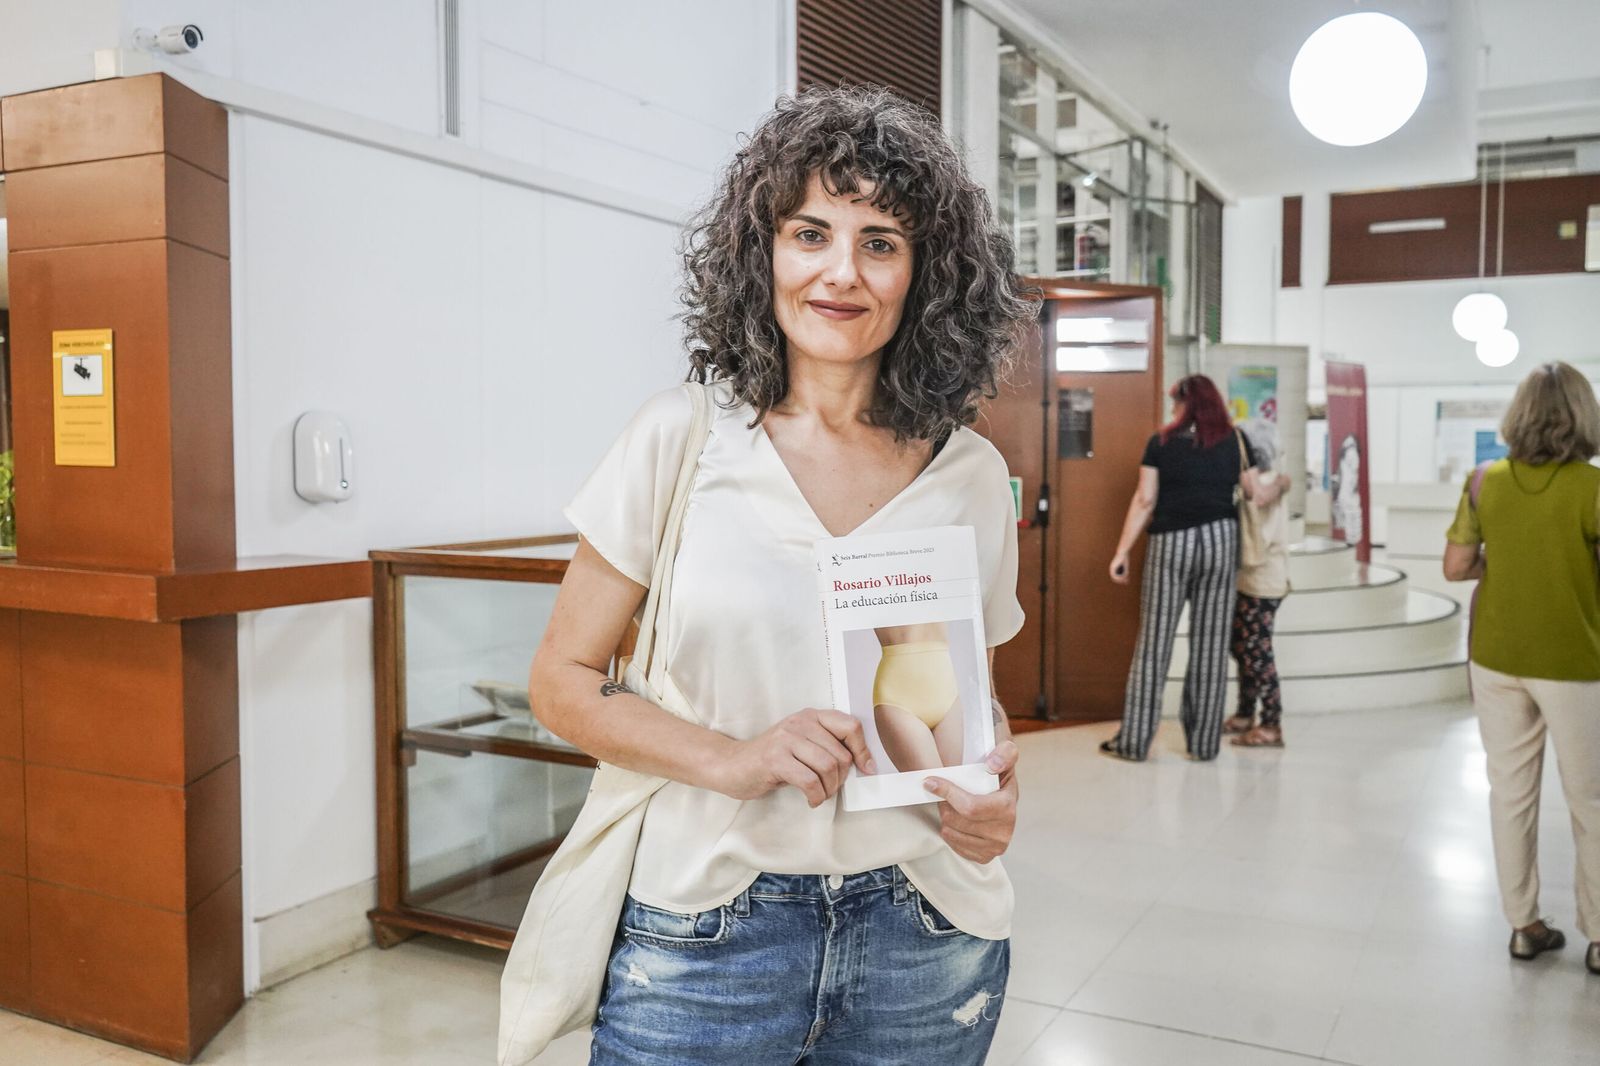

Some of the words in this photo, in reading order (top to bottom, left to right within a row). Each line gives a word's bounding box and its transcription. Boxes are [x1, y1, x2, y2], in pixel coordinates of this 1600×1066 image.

[833, 577, 882, 591] Rosario
[884, 573, 932, 588] Villajos
[834, 598, 849, 609] La
[851, 593, 908, 608] educación
[910, 590, 938, 602] física
